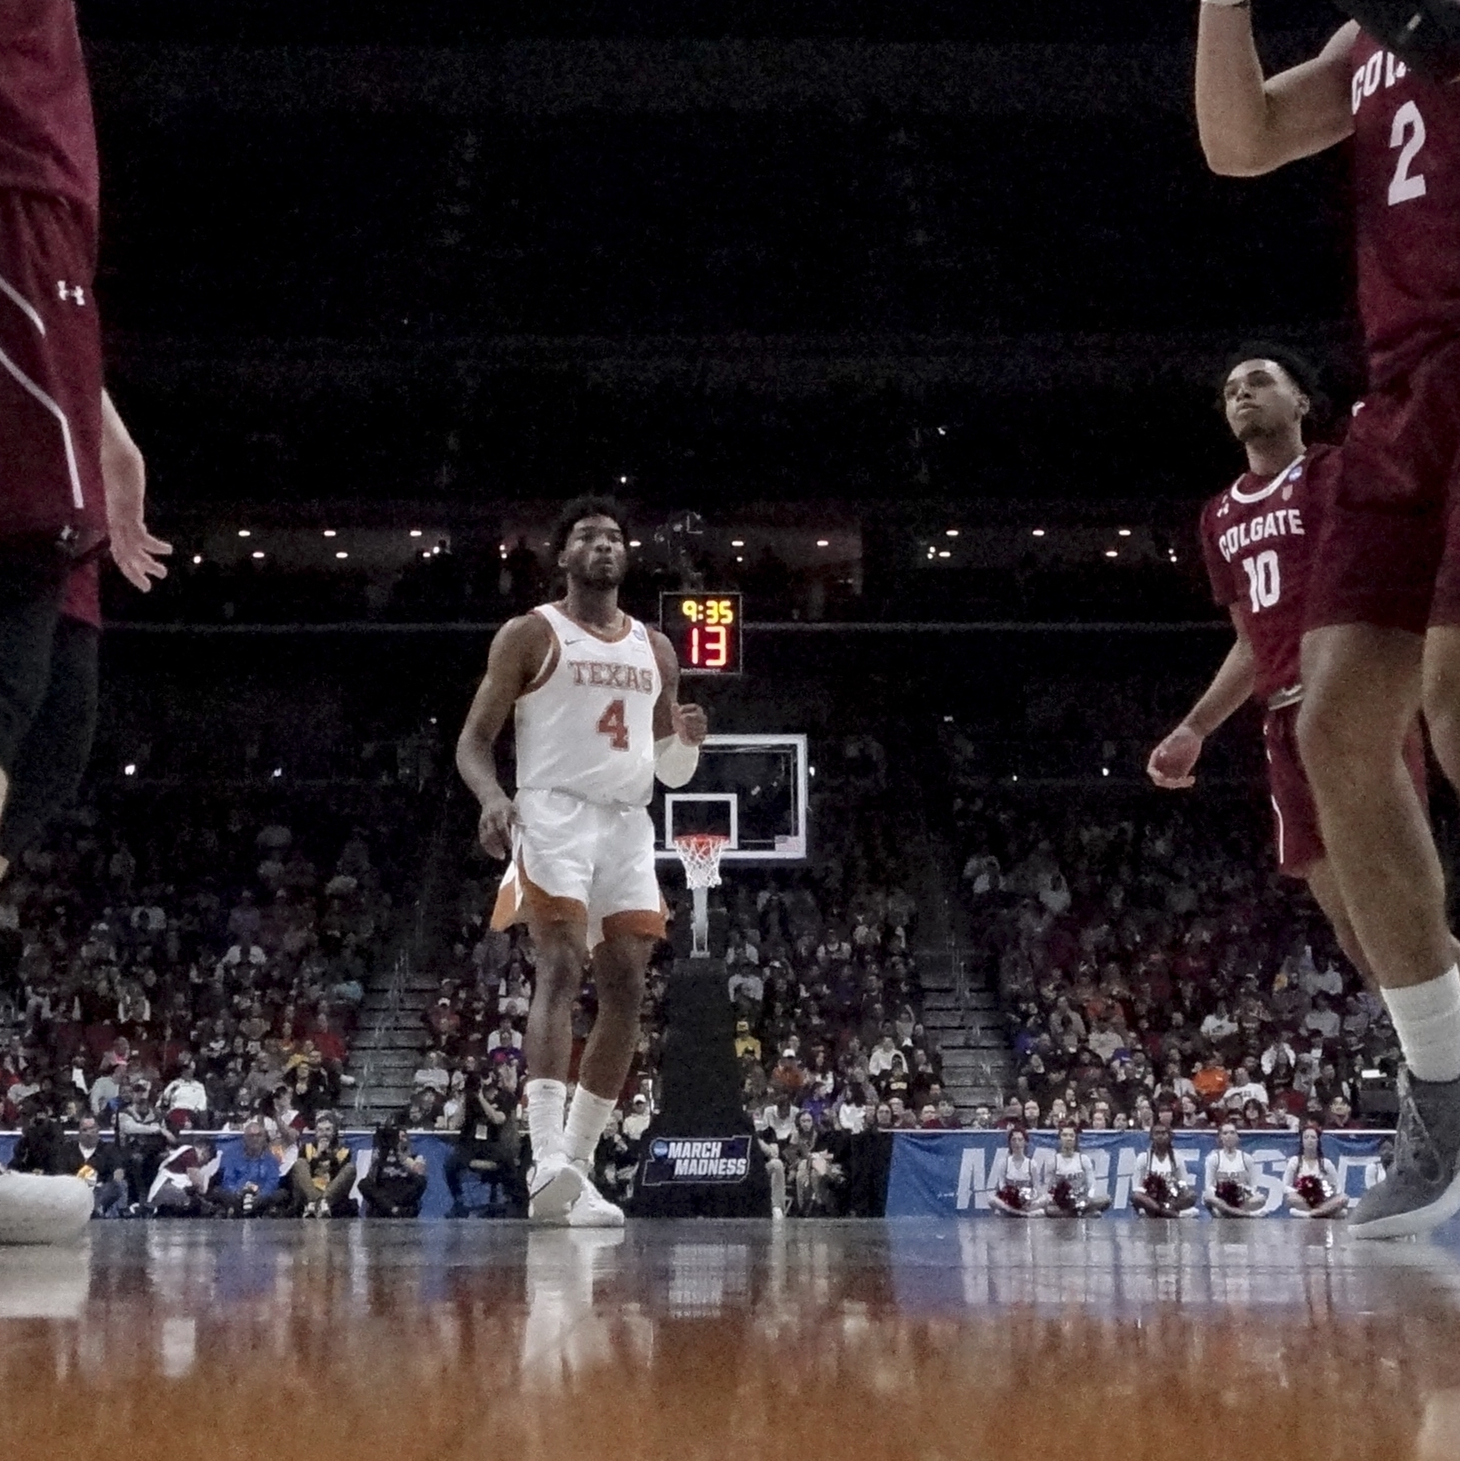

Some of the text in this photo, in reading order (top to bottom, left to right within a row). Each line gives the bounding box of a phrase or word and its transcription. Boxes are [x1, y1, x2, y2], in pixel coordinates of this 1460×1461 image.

[1388, 100, 1426, 206] 2
[1219, 509, 1306, 563] COLGATE
[1242, 549, 1280, 613] 10
[682, 600, 734, 624] 9:35
[691, 626, 728, 666] 13
[569, 661, 654, 694] TEXAS
[596, 697, 630, 752] 4
[668, 1142, 723, 1159] MARCH
[674, 1158, 747, 1176] MADNESS
